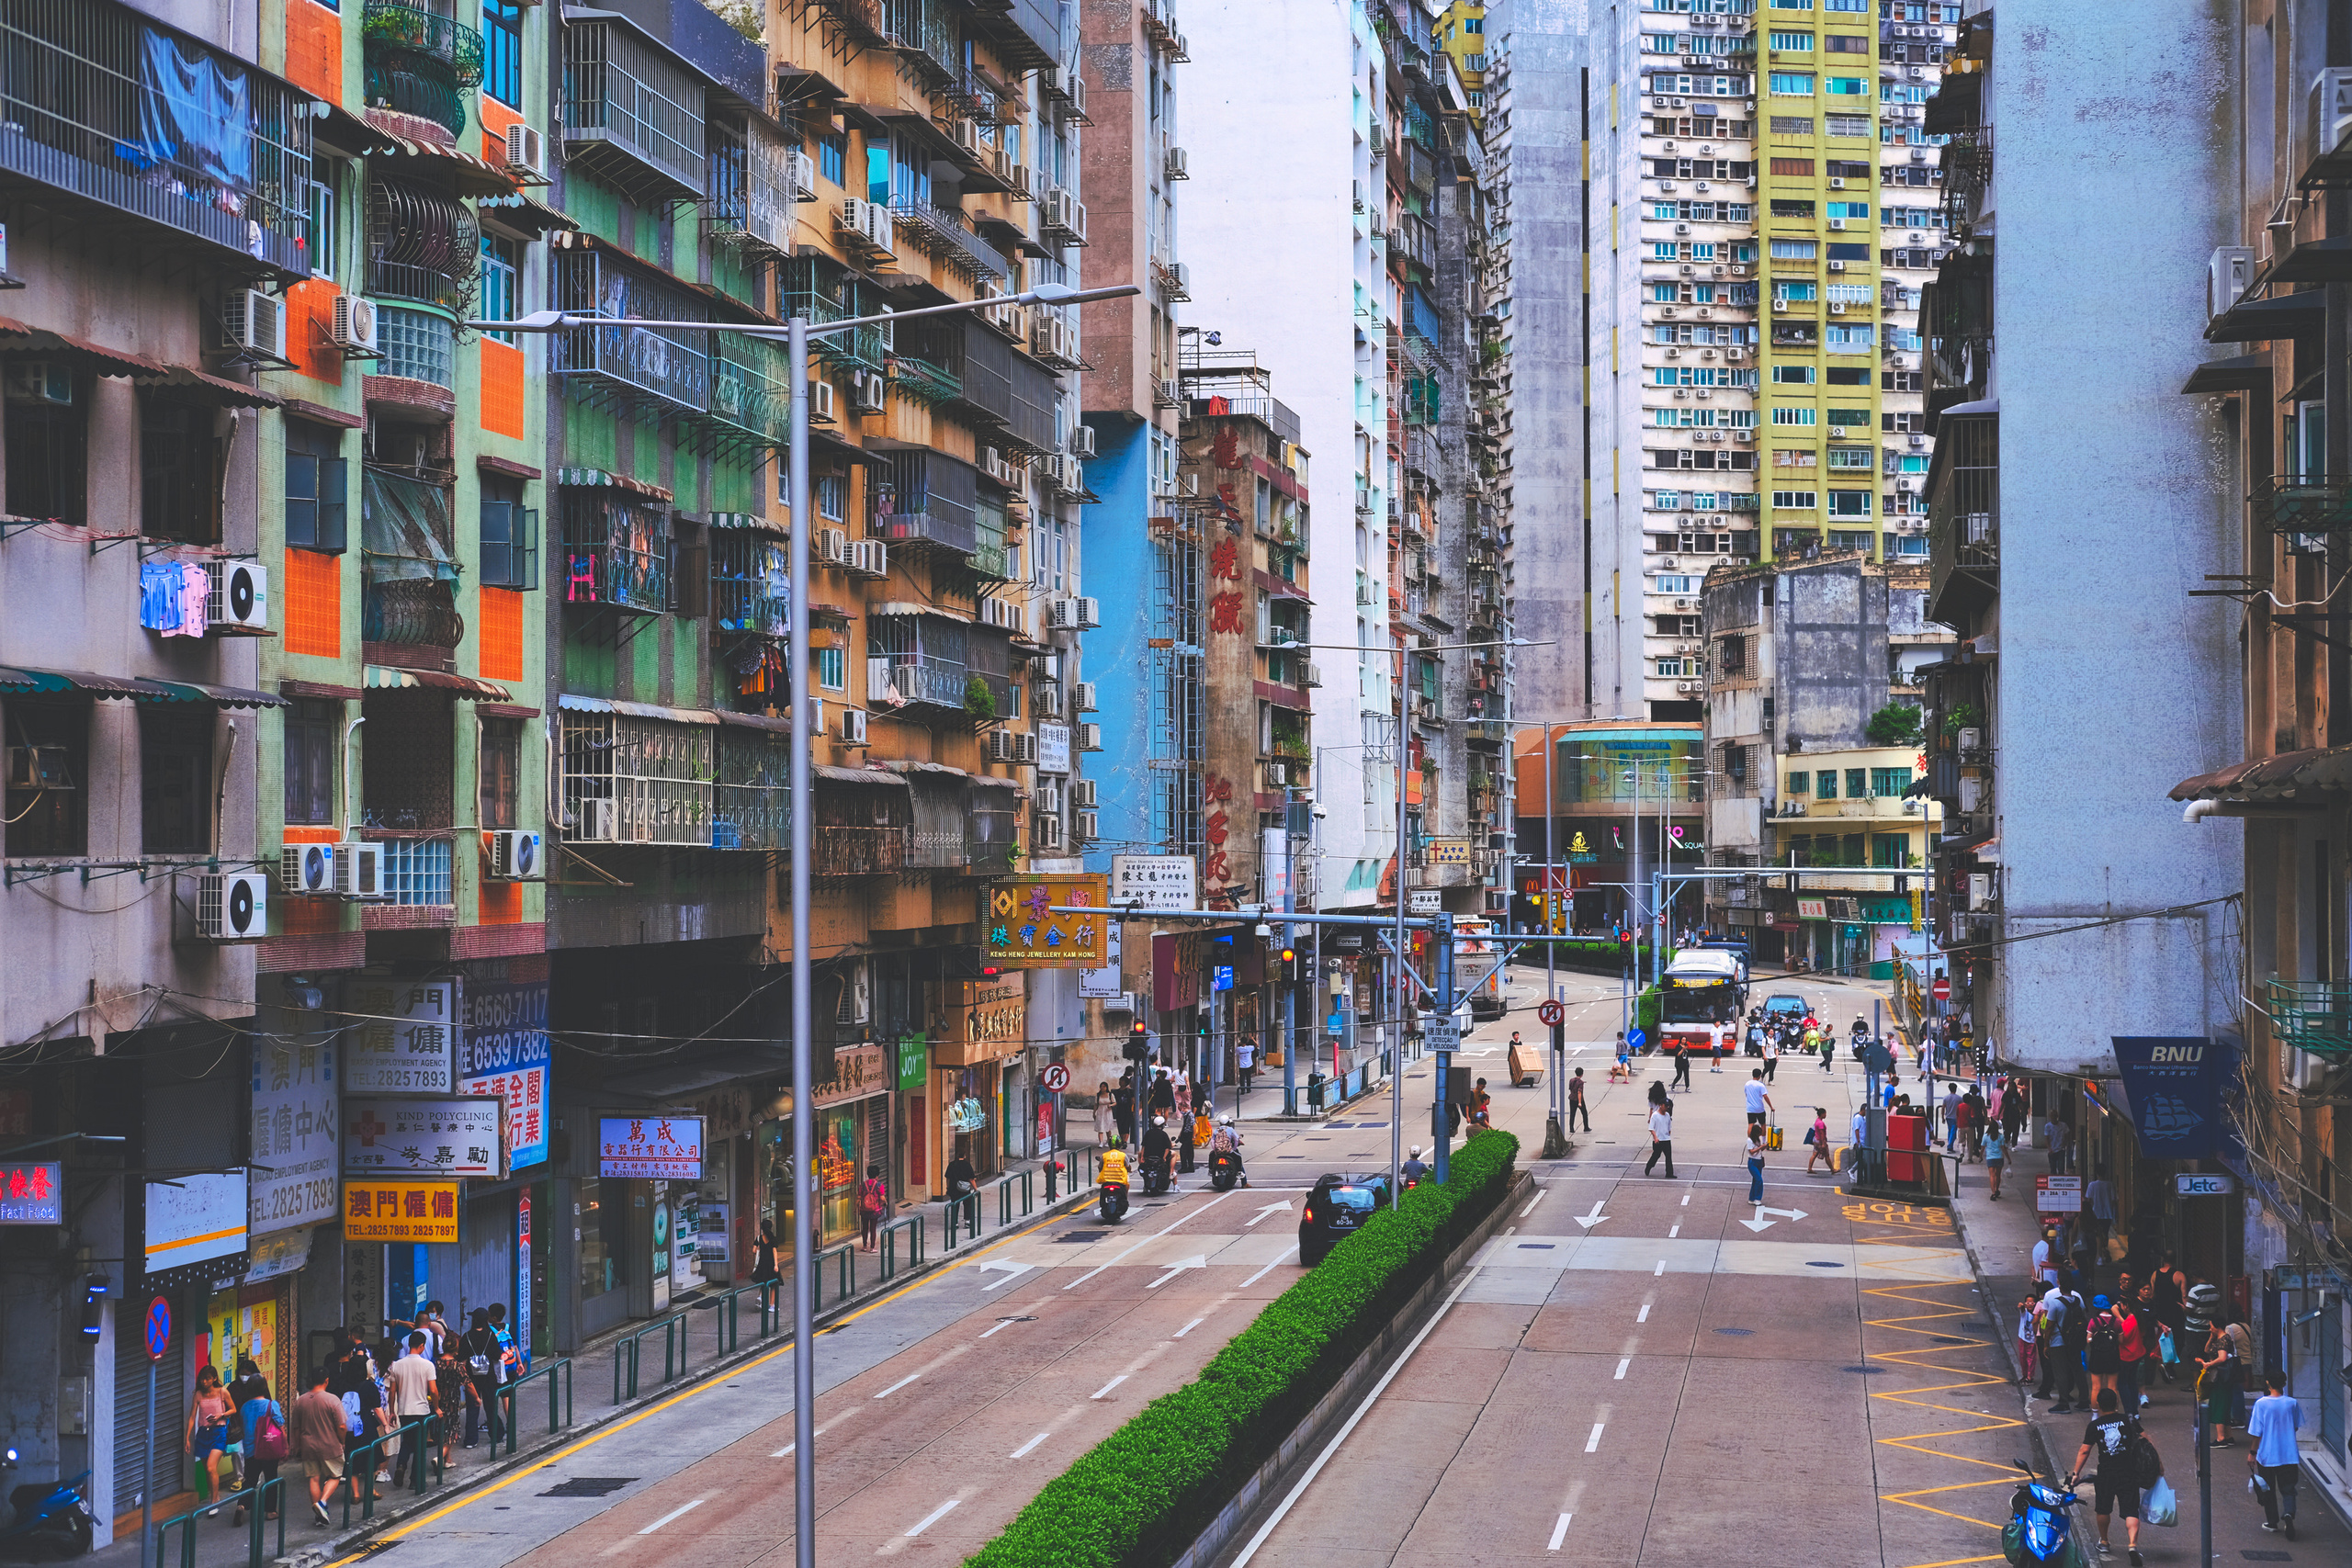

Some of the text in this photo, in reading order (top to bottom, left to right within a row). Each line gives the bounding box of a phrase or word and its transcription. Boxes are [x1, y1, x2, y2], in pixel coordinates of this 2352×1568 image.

[1122, 871, 1158, 882] 陳文龍
[990, 924, 1096, 948] 珠寶金行
[515, 988, 548, 1023] 7117
[1427, 1027, 1458, 1036] 速度偵測
[474, 1033, 512, 1071] 6539
[514, 1027, 548, 1063] 7382
[2151, 1046, 2203, 1062] BNU
[351, 1058, 374, 1066] MACAO
[376, 1058, 419, 1066] EMPLOYMENT
[901, 1054, 917, 1077] JOY
[414, 1071, 447, 1087] 7893
[396, 1112, 493, 1121] KIND POLYCLINIC
[252, 1100, 334, 1159] 僱傭中心
[396, 1122, 493, 1133] 嘉仁醫療中心
[628, 1120, 675, 1144] 萬成
[604, 1143, 697, 1157] 電器行有限公司
[351, 1155, 385, 1165] 女西醫
[274, 1162, 308, 1179] EMPLOYMENT
[310, 1158, 329, 1172] AGENCY
[2183, 1179, 2225, 1192] Jetco
[1, 1203, 54, 1220] Fast Food
[348, 1190, 454, 1218] 澳門僱傭
[520, 1210, 530, 1235] 租
[2097, 1421, 2125, 1431] HANNYA
